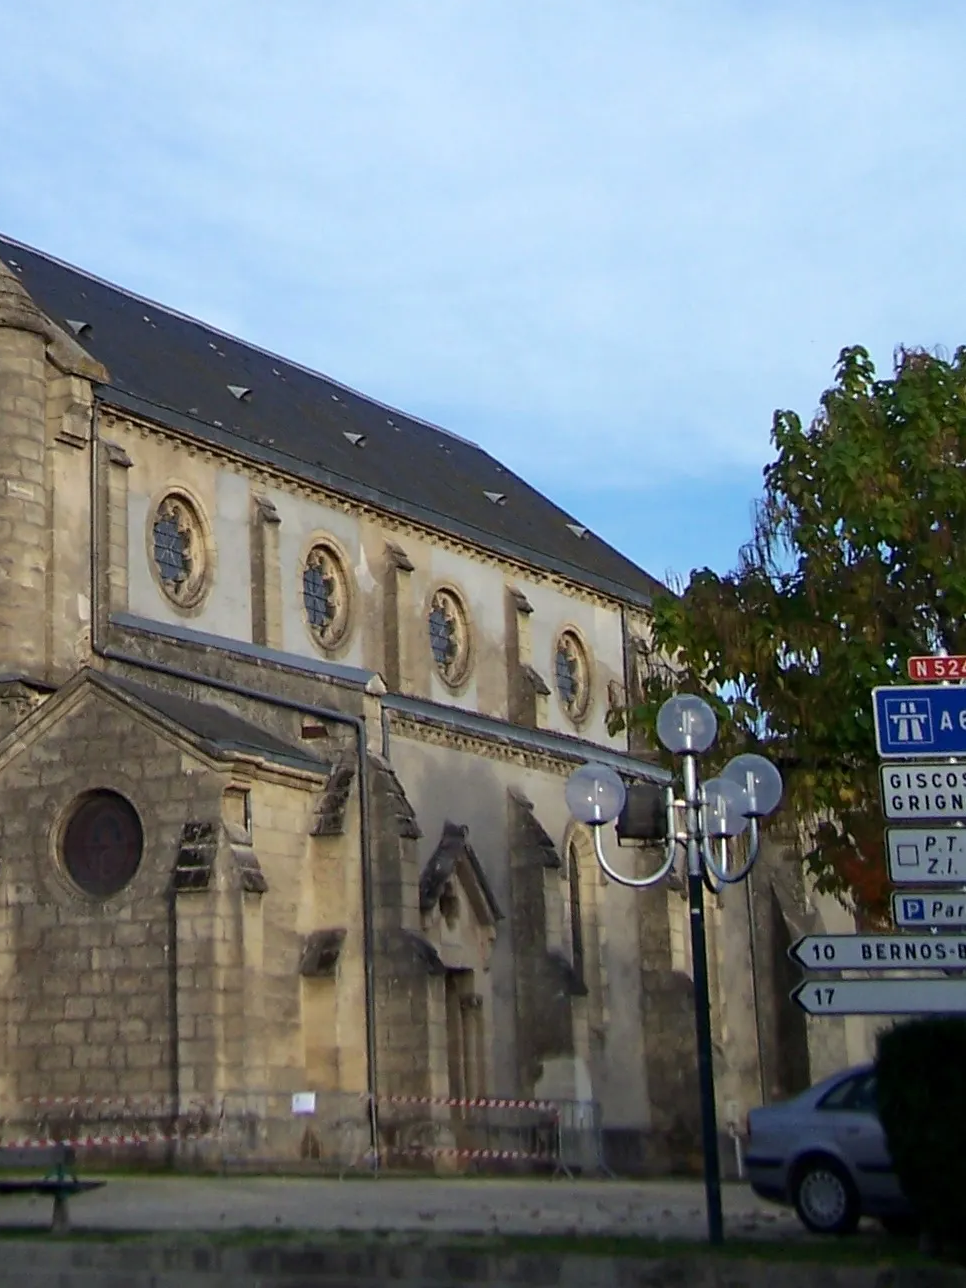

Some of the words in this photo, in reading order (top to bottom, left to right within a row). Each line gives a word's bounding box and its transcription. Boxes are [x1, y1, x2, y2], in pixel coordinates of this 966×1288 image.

[916, 661, 927, 676] N
[892, 794, 964, 810] GRIGN
[927, 857, 958, 875] Z.I.
[932, 901, 965, 918] Par
[812, 943, 835, 960] 10
[861, 943, 966, 960] BERNOS-B
[814, 987, 835, 1006] 17
